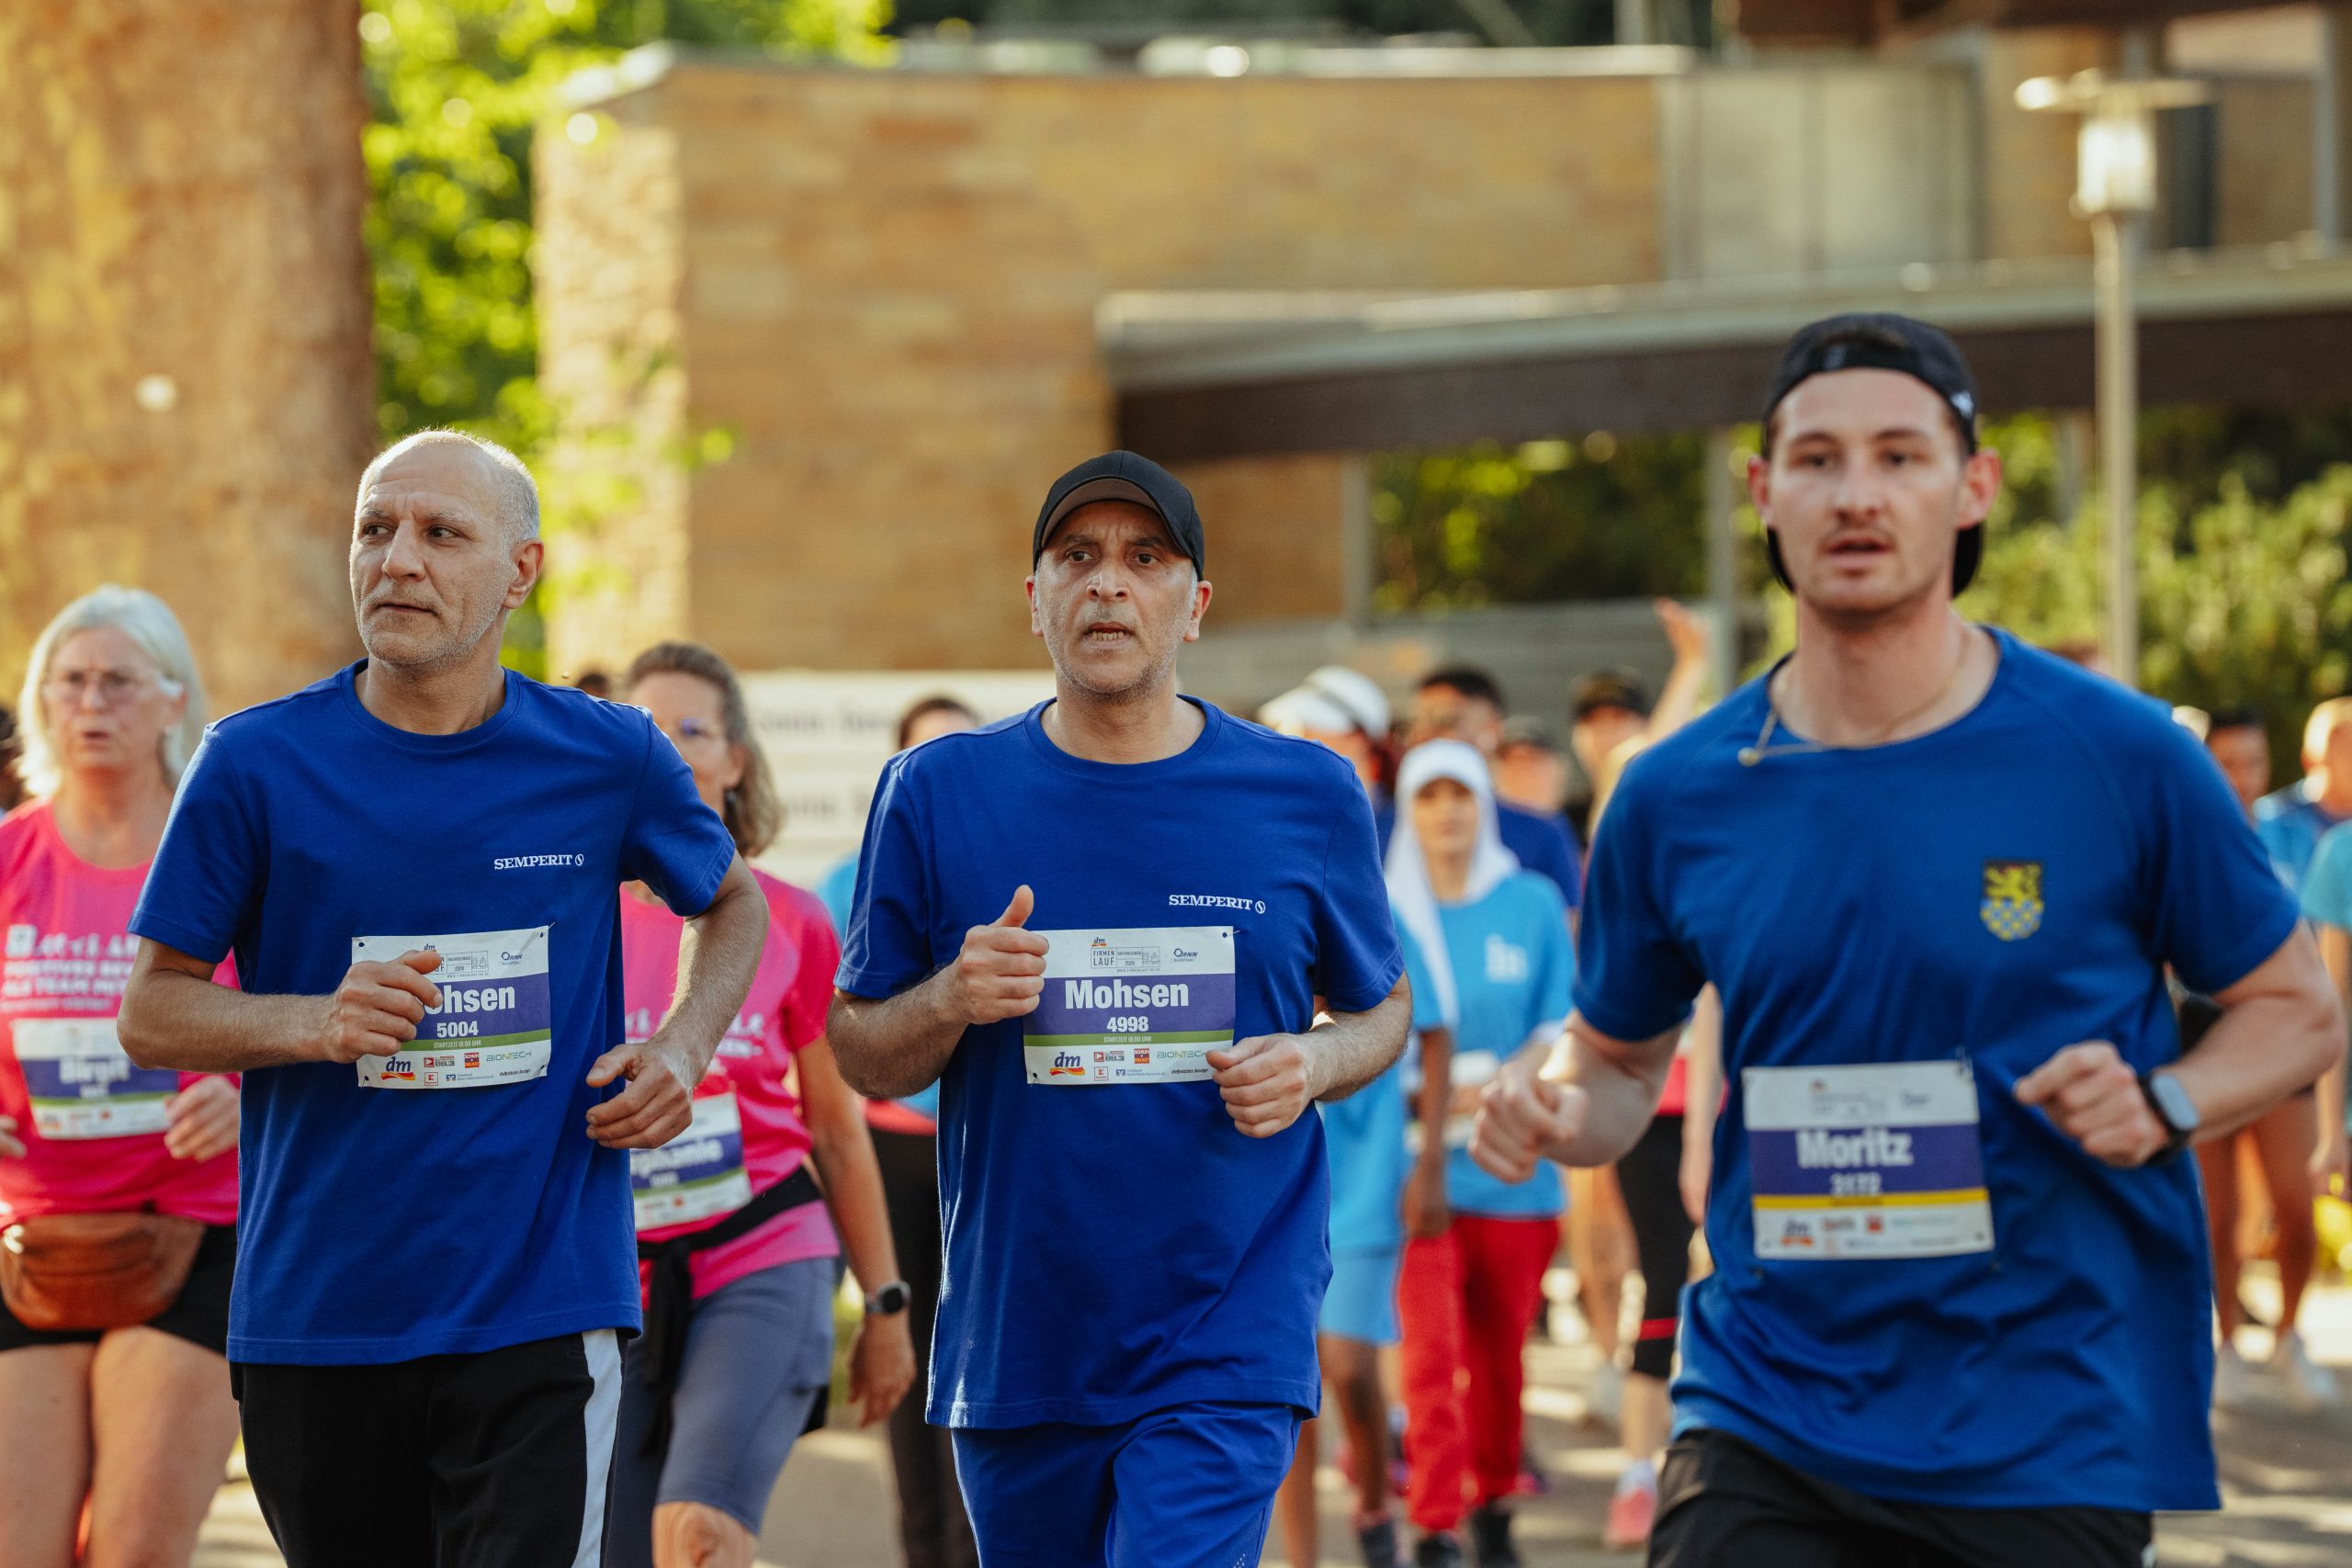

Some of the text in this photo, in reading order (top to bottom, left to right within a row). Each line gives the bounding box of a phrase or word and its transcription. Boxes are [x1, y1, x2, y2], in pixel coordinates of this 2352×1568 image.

[494, 854, 573, 870] SEMPERIT
[1169, 894, 1253, 910] SEMPERIT
[1093, 957, 1114, 966] LAUF
[1065, 979, 1189, 1009] Mohsen
[436, 1021, 479, 1038] 5004
[1106, 1016, 1148, 1032] 4998
[386, 1056, 411, 1072] dm
[486, 1051, 532, 1062] BIONTECH
[1054, 1052, 1080, 1067] dm
[1796, 1128, 1914, 1168] Moritz
